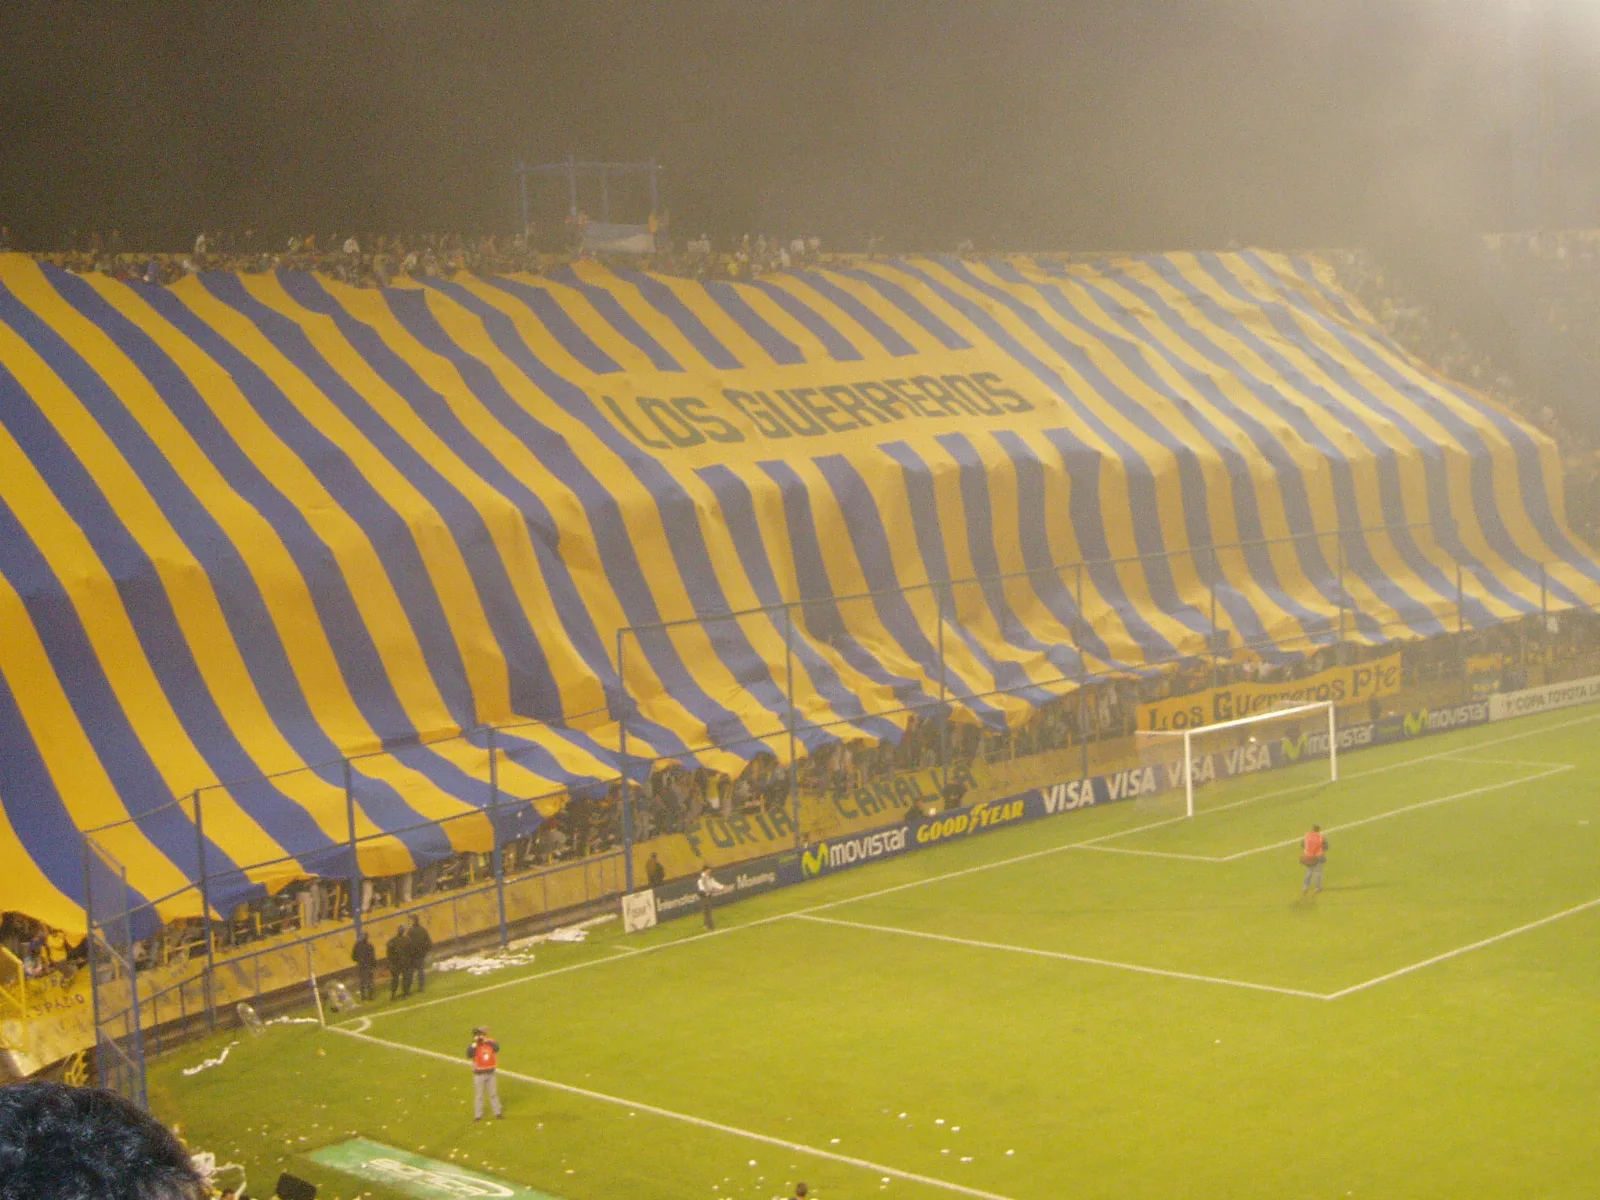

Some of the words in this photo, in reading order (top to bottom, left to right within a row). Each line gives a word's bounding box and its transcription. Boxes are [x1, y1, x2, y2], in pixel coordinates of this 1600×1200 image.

[601, 394, 746, 450] LOS
[720, 371, 1036, 440] GUERREROS
[1149, 704, 1205, 731] Los
[1042, 778, 1096, 814] VISA
[1104, 766, 1157, 800] VISA
[1223, 743, 1272, 775] VISA
[916, 803, 1025, 845] GOODYEAR
